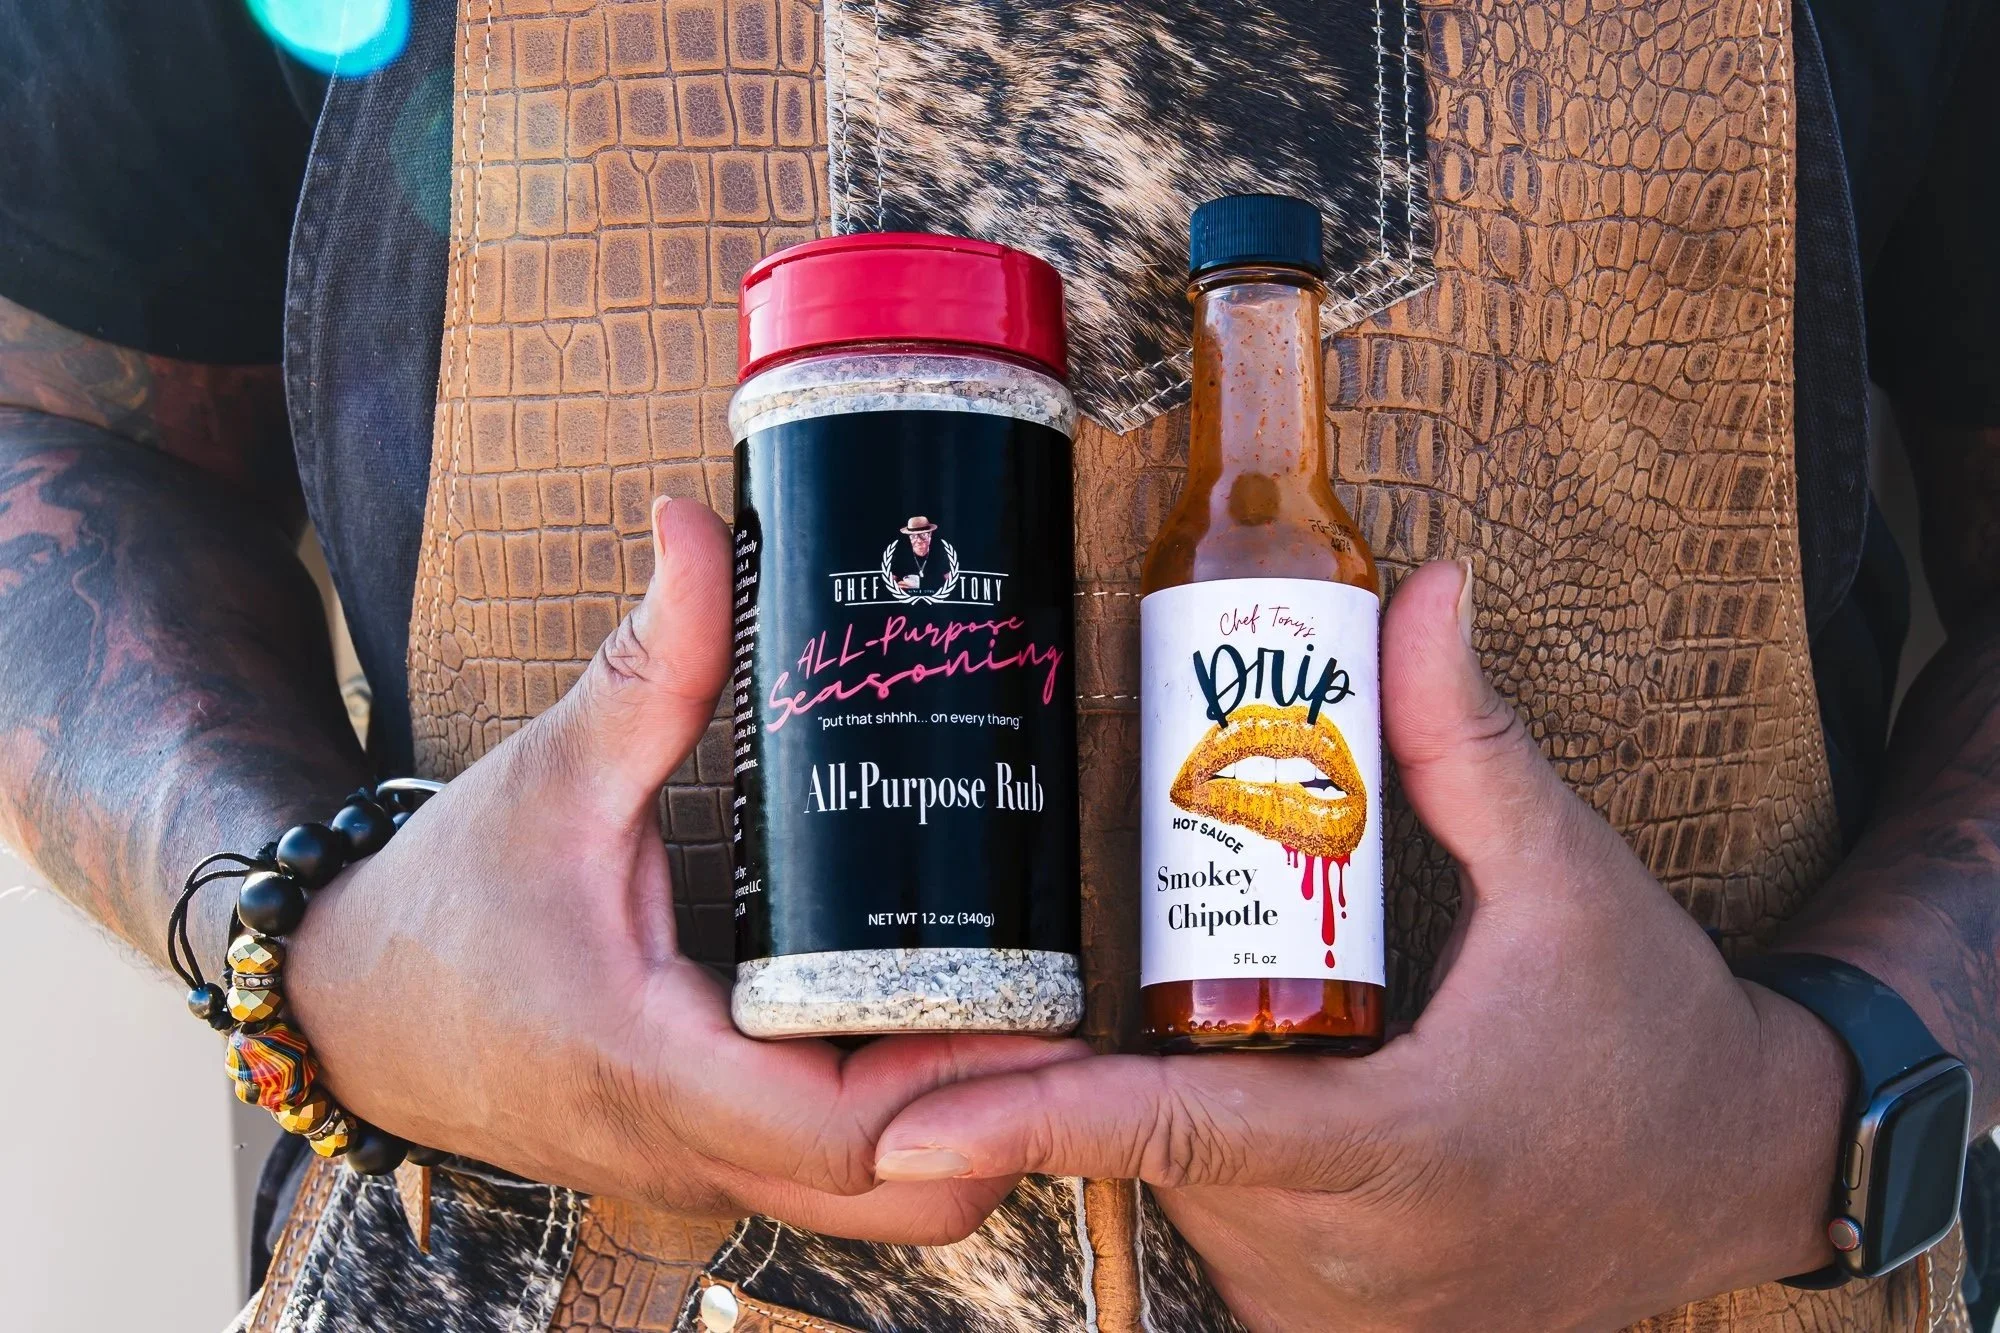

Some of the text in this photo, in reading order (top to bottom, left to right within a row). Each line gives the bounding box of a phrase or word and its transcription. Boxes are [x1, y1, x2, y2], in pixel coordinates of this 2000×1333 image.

[835, 577, 1001, 602] CHEF TONY
[1220, 604, 1260, 635] Chef
[766, 640, 1064, 733] Seasoning
[1192, 643, 1356, 729] Drip
[846, 713, 872, 727] that
[876, 711, 928, 724] shhhh...
[931, 713, 948, 723] on
[950, 713, 985, 728] every
[804, 760, 1044, 825] All-Purpose Rub
[1173, 817, 1244, 855] HOT SAUCE
[749, 879, 762, 894] LLC
[1157, 861, 1257, 895] Smokey
[868, 912, 995, 928] NET WT 12 oz (340g)
[1168, 900, 1279, 936] Chipotle
[1233, 952, 1277, 964] 5 FL oz
